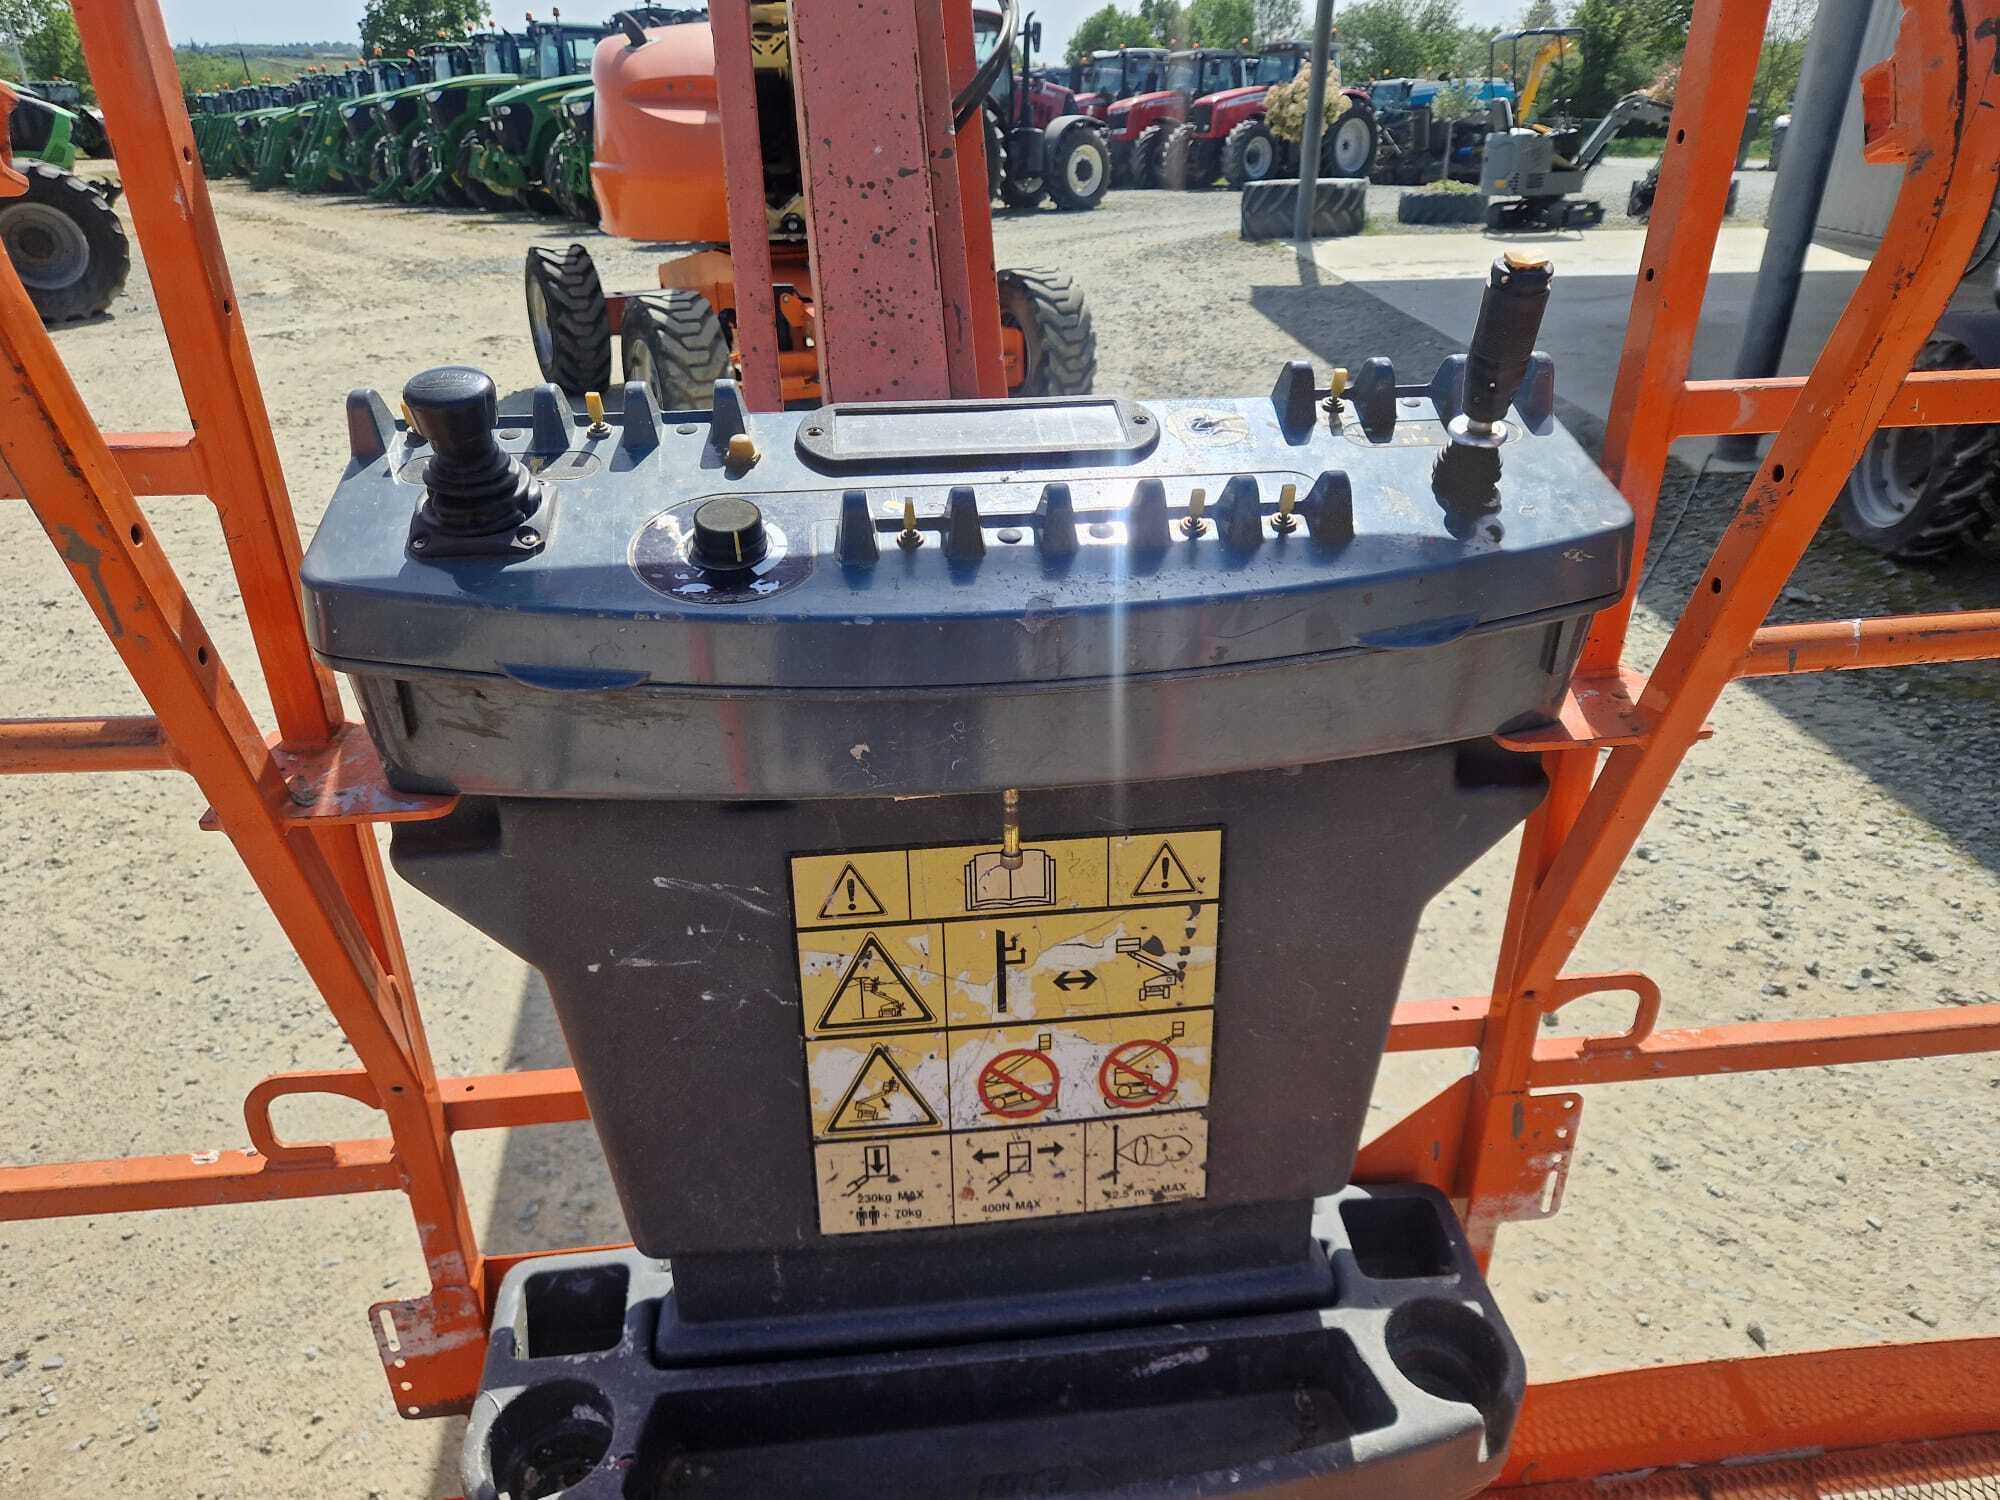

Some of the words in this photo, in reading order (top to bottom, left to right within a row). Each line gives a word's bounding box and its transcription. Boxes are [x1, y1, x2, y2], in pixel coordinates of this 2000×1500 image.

[897, 1189, 925, 1202] MAX
[981, 1202, 1011, 1214] 400N
[1015, 1199, 1042, 1212] MAX
[894, 1207, 923, 1220] 70kg
